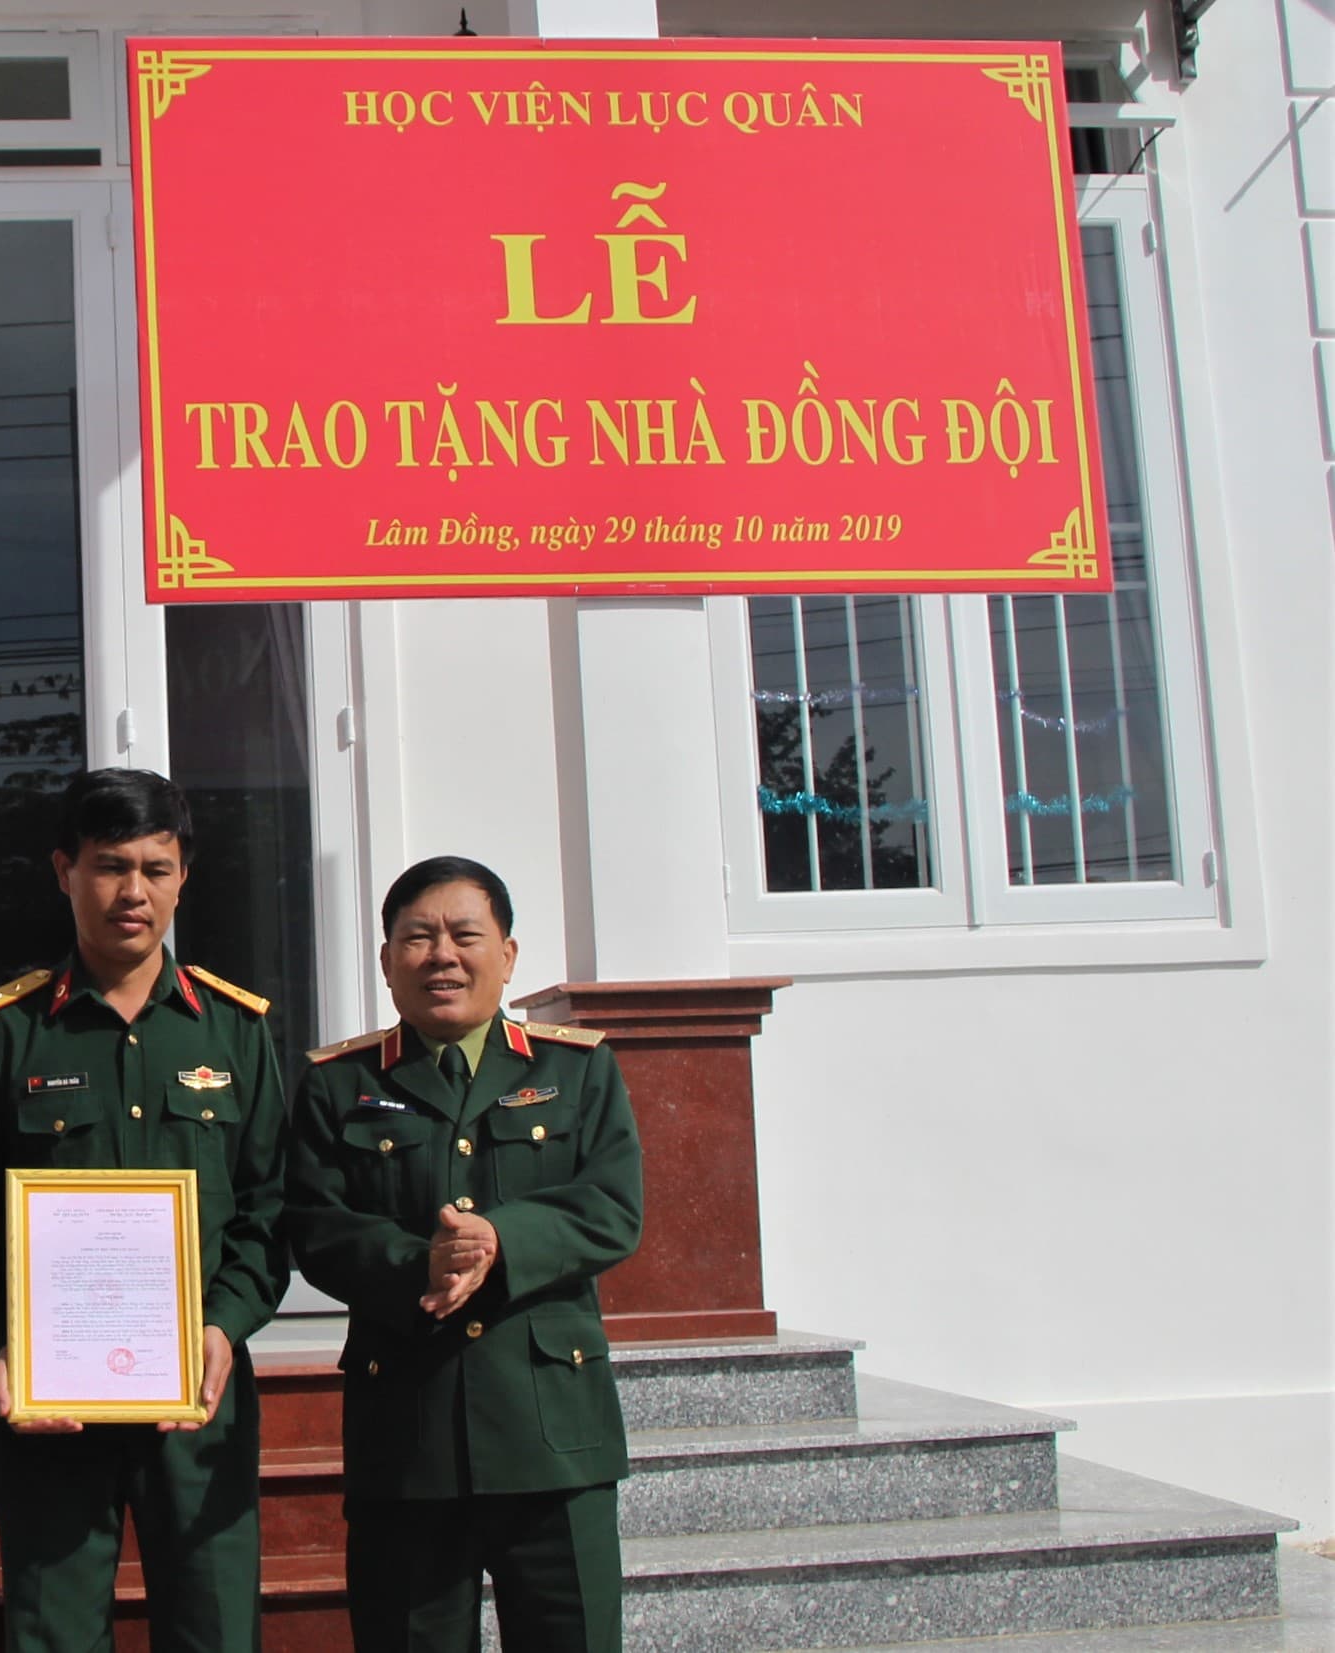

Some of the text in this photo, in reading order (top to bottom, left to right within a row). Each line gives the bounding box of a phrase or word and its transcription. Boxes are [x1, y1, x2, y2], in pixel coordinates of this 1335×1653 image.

[342, 80, 864, 134] HỌC VIỆN LỤC QUÂN
[490, 181, 697, 325] LỄ
[185, 360, 1060, 483] TRAO TẶNG NHÀ ĐỒNG ĐỘI
[364, 511, 903, 552] Lâm Đồng, ngày 29 tháng 10 năm 2019
